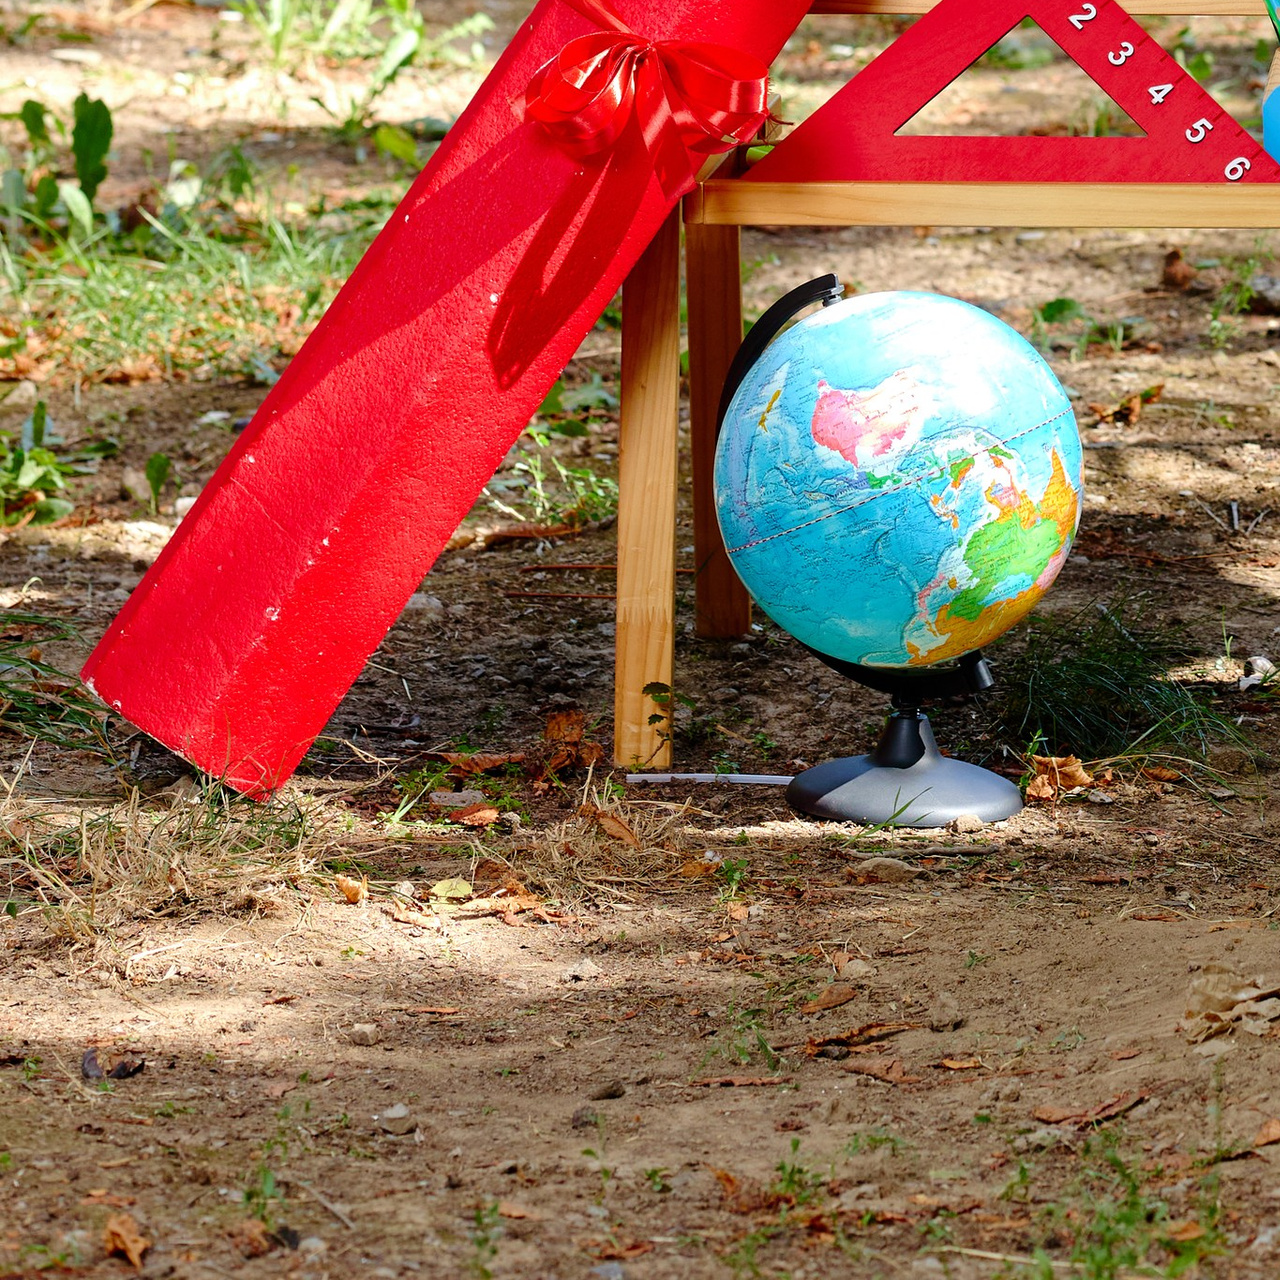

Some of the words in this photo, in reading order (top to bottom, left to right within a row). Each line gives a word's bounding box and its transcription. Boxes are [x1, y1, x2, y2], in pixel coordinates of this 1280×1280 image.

[1067, 3, 1097, 30] 2
[1108, 41, 1134, 66] 3
[1146, 81, 1174, 105] 4
[1185, 117, 1214, 143] 5
[1223, 156, 1251, 181] 6
